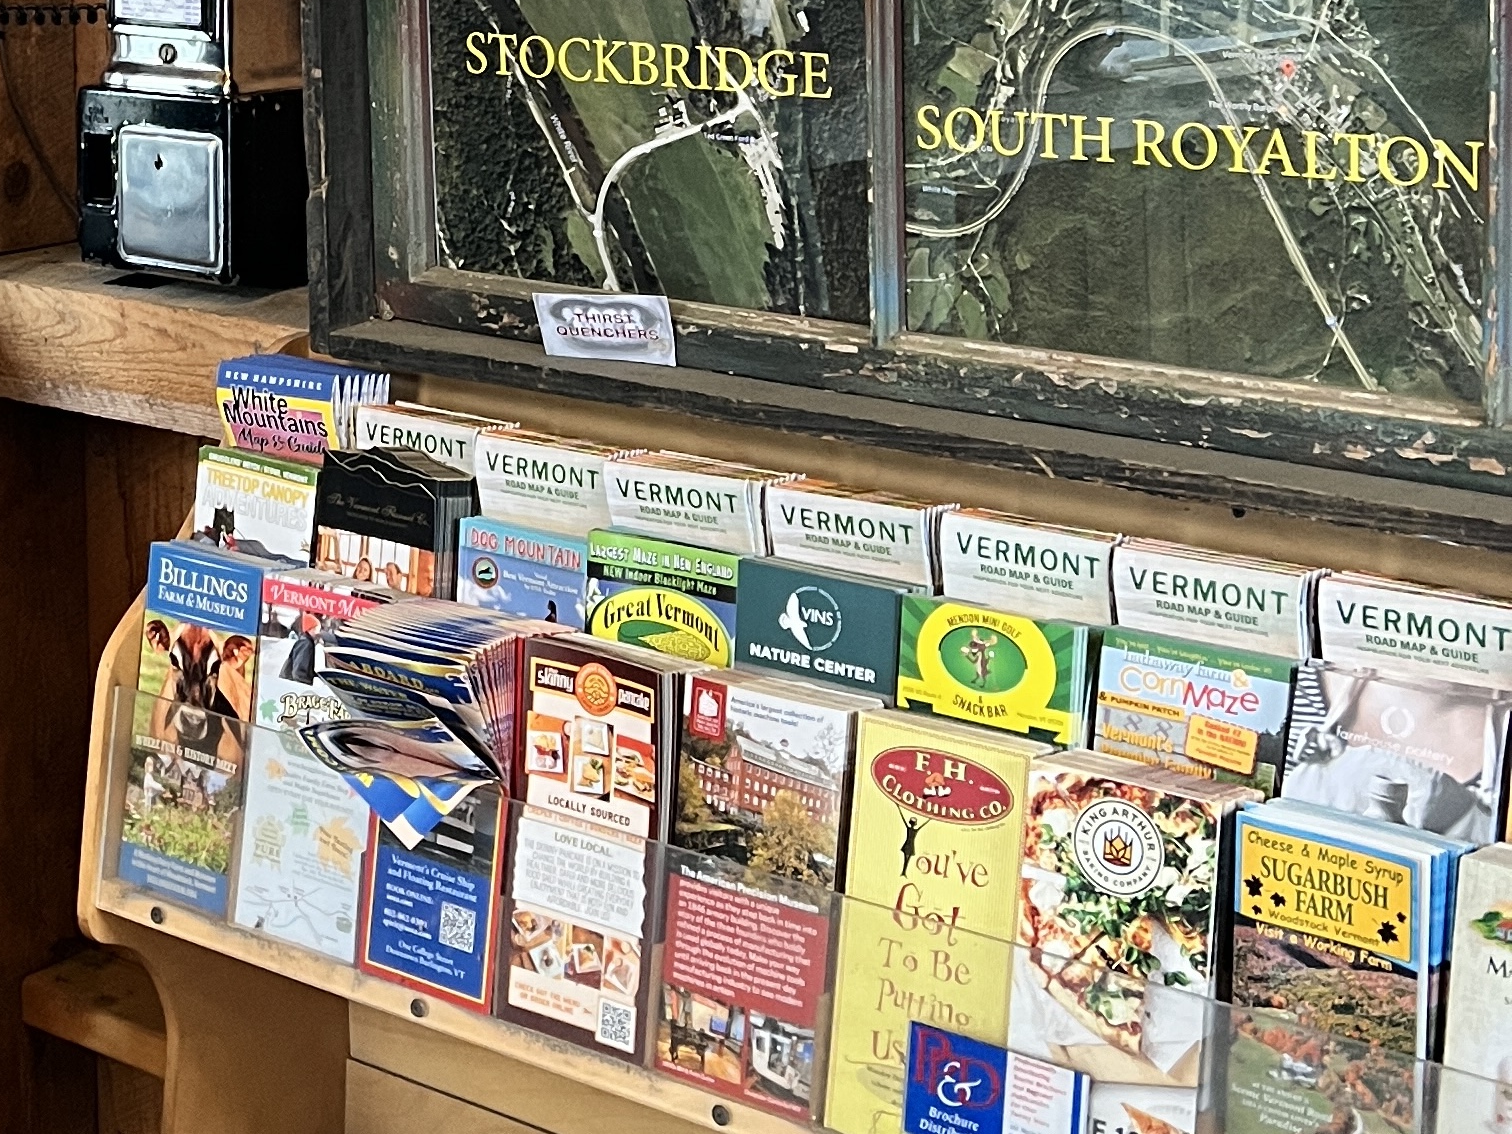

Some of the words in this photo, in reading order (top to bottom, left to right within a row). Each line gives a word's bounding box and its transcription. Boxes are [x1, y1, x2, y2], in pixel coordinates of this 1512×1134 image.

[466, 32, 833, 100] STOCKBRIDGE
[917, 105, 1115, 164] SOUTH
[1133, 118, 1484, 191] ROYALTON
[557, 326, 659, 340] QUENCHERS
[573, 314, 634, 323] THIRST
[225, 371, 248, 381] NEW
[253, 374, 322, 391] HAMPSHIRE
[233, 385, 288, 416] White
[223, 403, 328, 438] Mountains
[367, 421, 466, 459] VERMONT
[207, 469, 259, 491] TREETOP
[261, 480, 309, 508] CANOPY
[486, 450, 599, 490] VERMONT
[203, 484, 308, 531] ADVENTURES
[616, 477, 738, 514] VERMONT
[781, 504, 913, 546] VERMONT
[470, 527, 499, 549] DOG
[505, 536, 581, 568] MOUNTAIN
[957, 532, 1100, 579] VERMONT
[160, 558, 248, 603] BILLINGS
[1129, 566, 1288, 615] VERMONT
[159, 587, 184, 604] FARM
[185, 594, 195, 609] &
[196, 596, 244, 620] MUSEUM
[604, 594, 651, 629] Great
[656, 594, 720, 652] Vermont
[801, 607, 834, 626] VINS
[1156, 599, 1180, 613] ROAD
[1183, 603, 1211, 617] MAP
[1214, 610, 1221, 620] &
[1225, 610, 1259, 626] GUIDE
[1336, 599, 1512, 652] VERMONT
[749, 643, 810, 669] NATURE
[814, 657, 876, 684] CENTER
[1366, 634, 1397, 648] ROAD
[1400, 640, 1426, 653] MAP
[1430, 645, 1438, 655] &
[1441, 648, 1479, 663] GUIDE
[538, 667, 573, 692] skinny
[1120, 667, 1187, 697] Corn
[1182, 682, 1259, 715] Maze
[618, 688, 649, 711] pancake
[953, 694, 986, 718] SNACK
[987, 704, 1007, 718] BAR
[1099, 692, 1107, 701] &
[1110, 695, 1148, 712] PUMPKIN
[1150, 703, 1180, 717] PATCH
[1336, 726, 1399, 751] farmhouse
[1405, 741, 1455, 764] pottery
[548, 795, 586, 813] LOCALLY
[591, 807, 630, 826] SOURCED
[882, 774, 975, 820] CLOTHING
[980, 801, 1006, 818] CO.
[1081, 808, 1107, 835] KING
[1112, 807, 1155, 852] ARTHUR
[1083, 850, 1109, 884] BAKING
[1113, 867, 1151, 888] COMPANY
[1248, 831, 1293, 854] Cheese
[1301, 844, 1310, 858] &
[1318, 848, 1357, 870] Maple
[1364, 861, 1403, 885] Syrup
[1260, 856, 1388, 910] SUGARBUSH
[892, 883, 965, 946] Got
[1295, 890, 1354, 926] FARM
[1256, 922, 1284, 940] Visit
[1289, 935, 1297, 944] a
[1304, 935, 1355, 963] Working
[1360, 951, 1393, 971] Farm
[1269, 909, 1328, 933] Woodstock
[1334, 924, 1379, 947] Vermont
[878, 937, 918, 973] To
[929, 950, 972, 986] Be
[876, 977, 972, 1030] Putting
